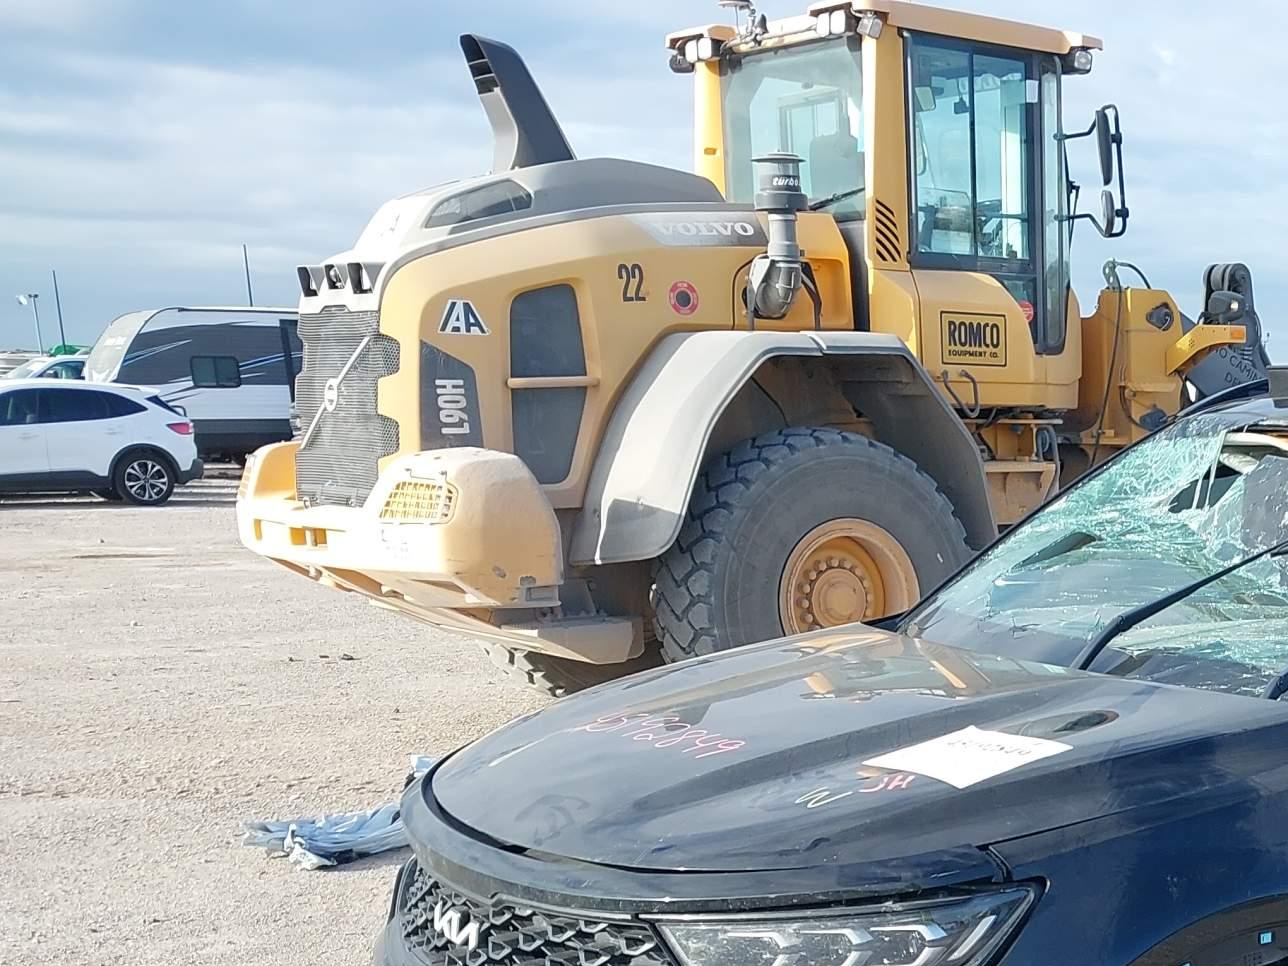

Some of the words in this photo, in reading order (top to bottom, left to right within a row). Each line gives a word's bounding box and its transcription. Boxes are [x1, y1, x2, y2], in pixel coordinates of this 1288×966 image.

[655, 222, 754, 236] VOLVO
[617, 263, 647, 302] 22
[439, 301, 488, 334] IAA
[947, 320, 1000, 348] ROMCO
[948, 349, 987, 358] EQUIPMENT
[435, 378, 471, 434] L90H
